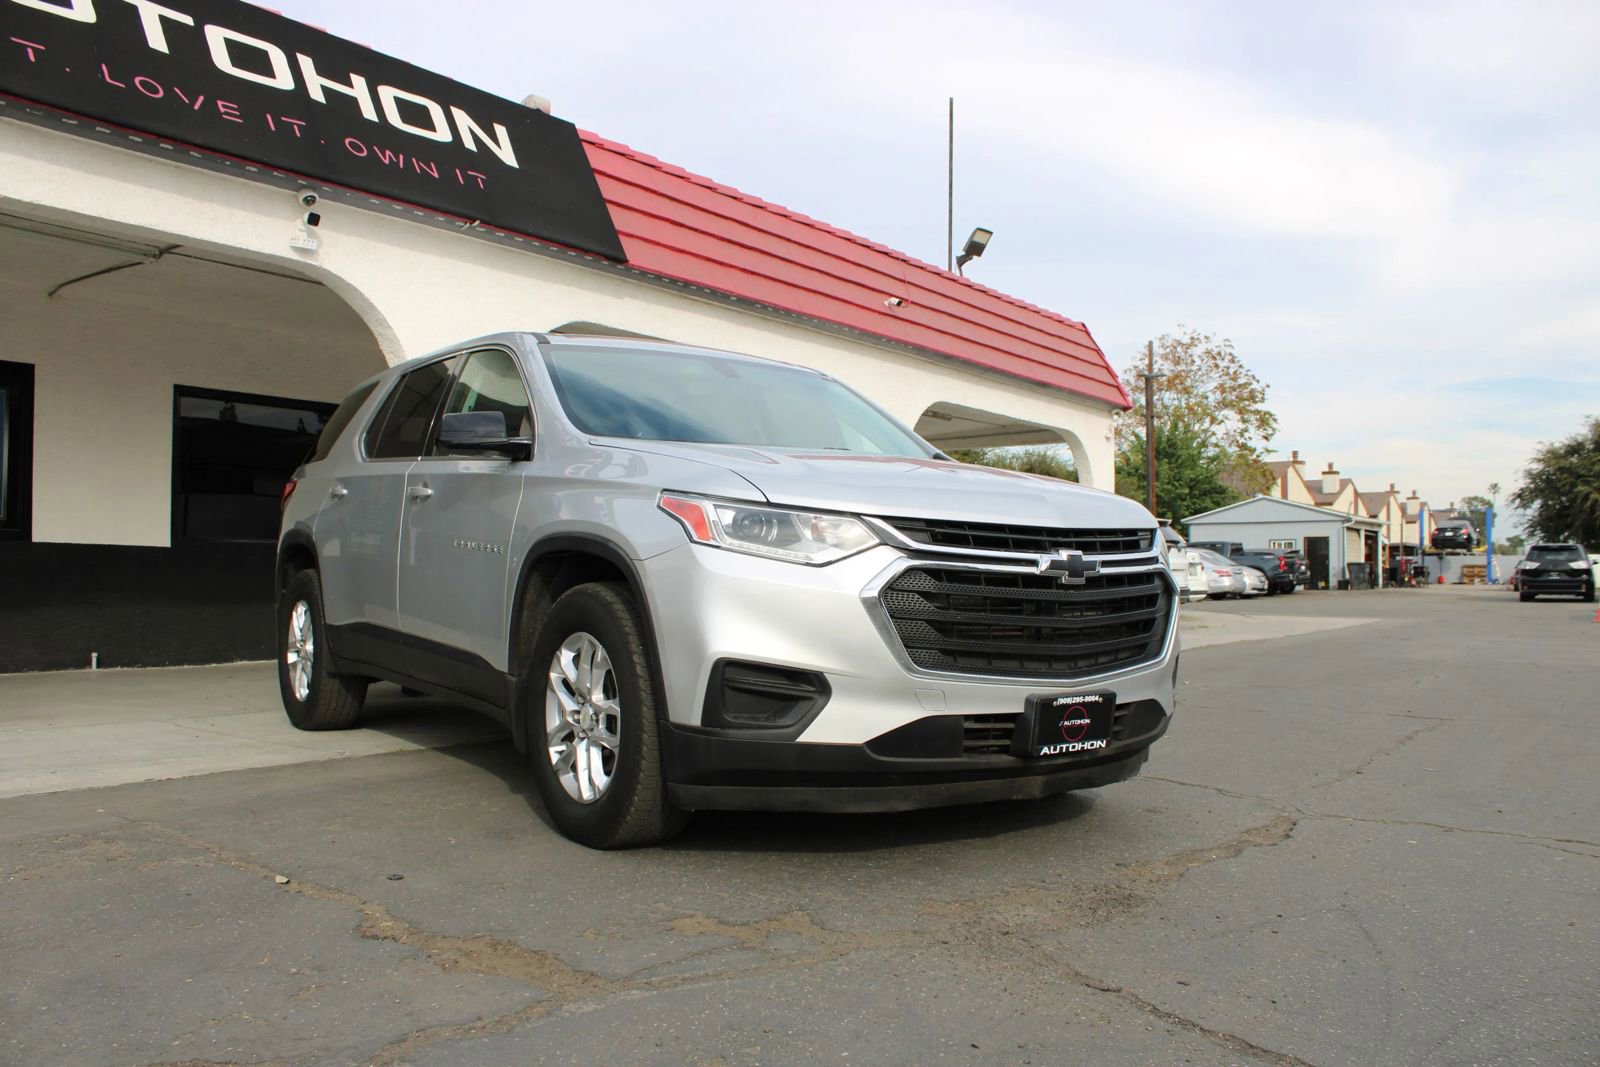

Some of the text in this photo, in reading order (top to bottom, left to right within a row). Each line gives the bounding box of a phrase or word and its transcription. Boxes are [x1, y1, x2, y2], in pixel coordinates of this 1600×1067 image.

[100, 62, 245, 123] LOVE
[343, 137, 439, 179] OWN
[455, 168, 487, 190] IT
[1039, 739, 1107, 756] AUTOHON
